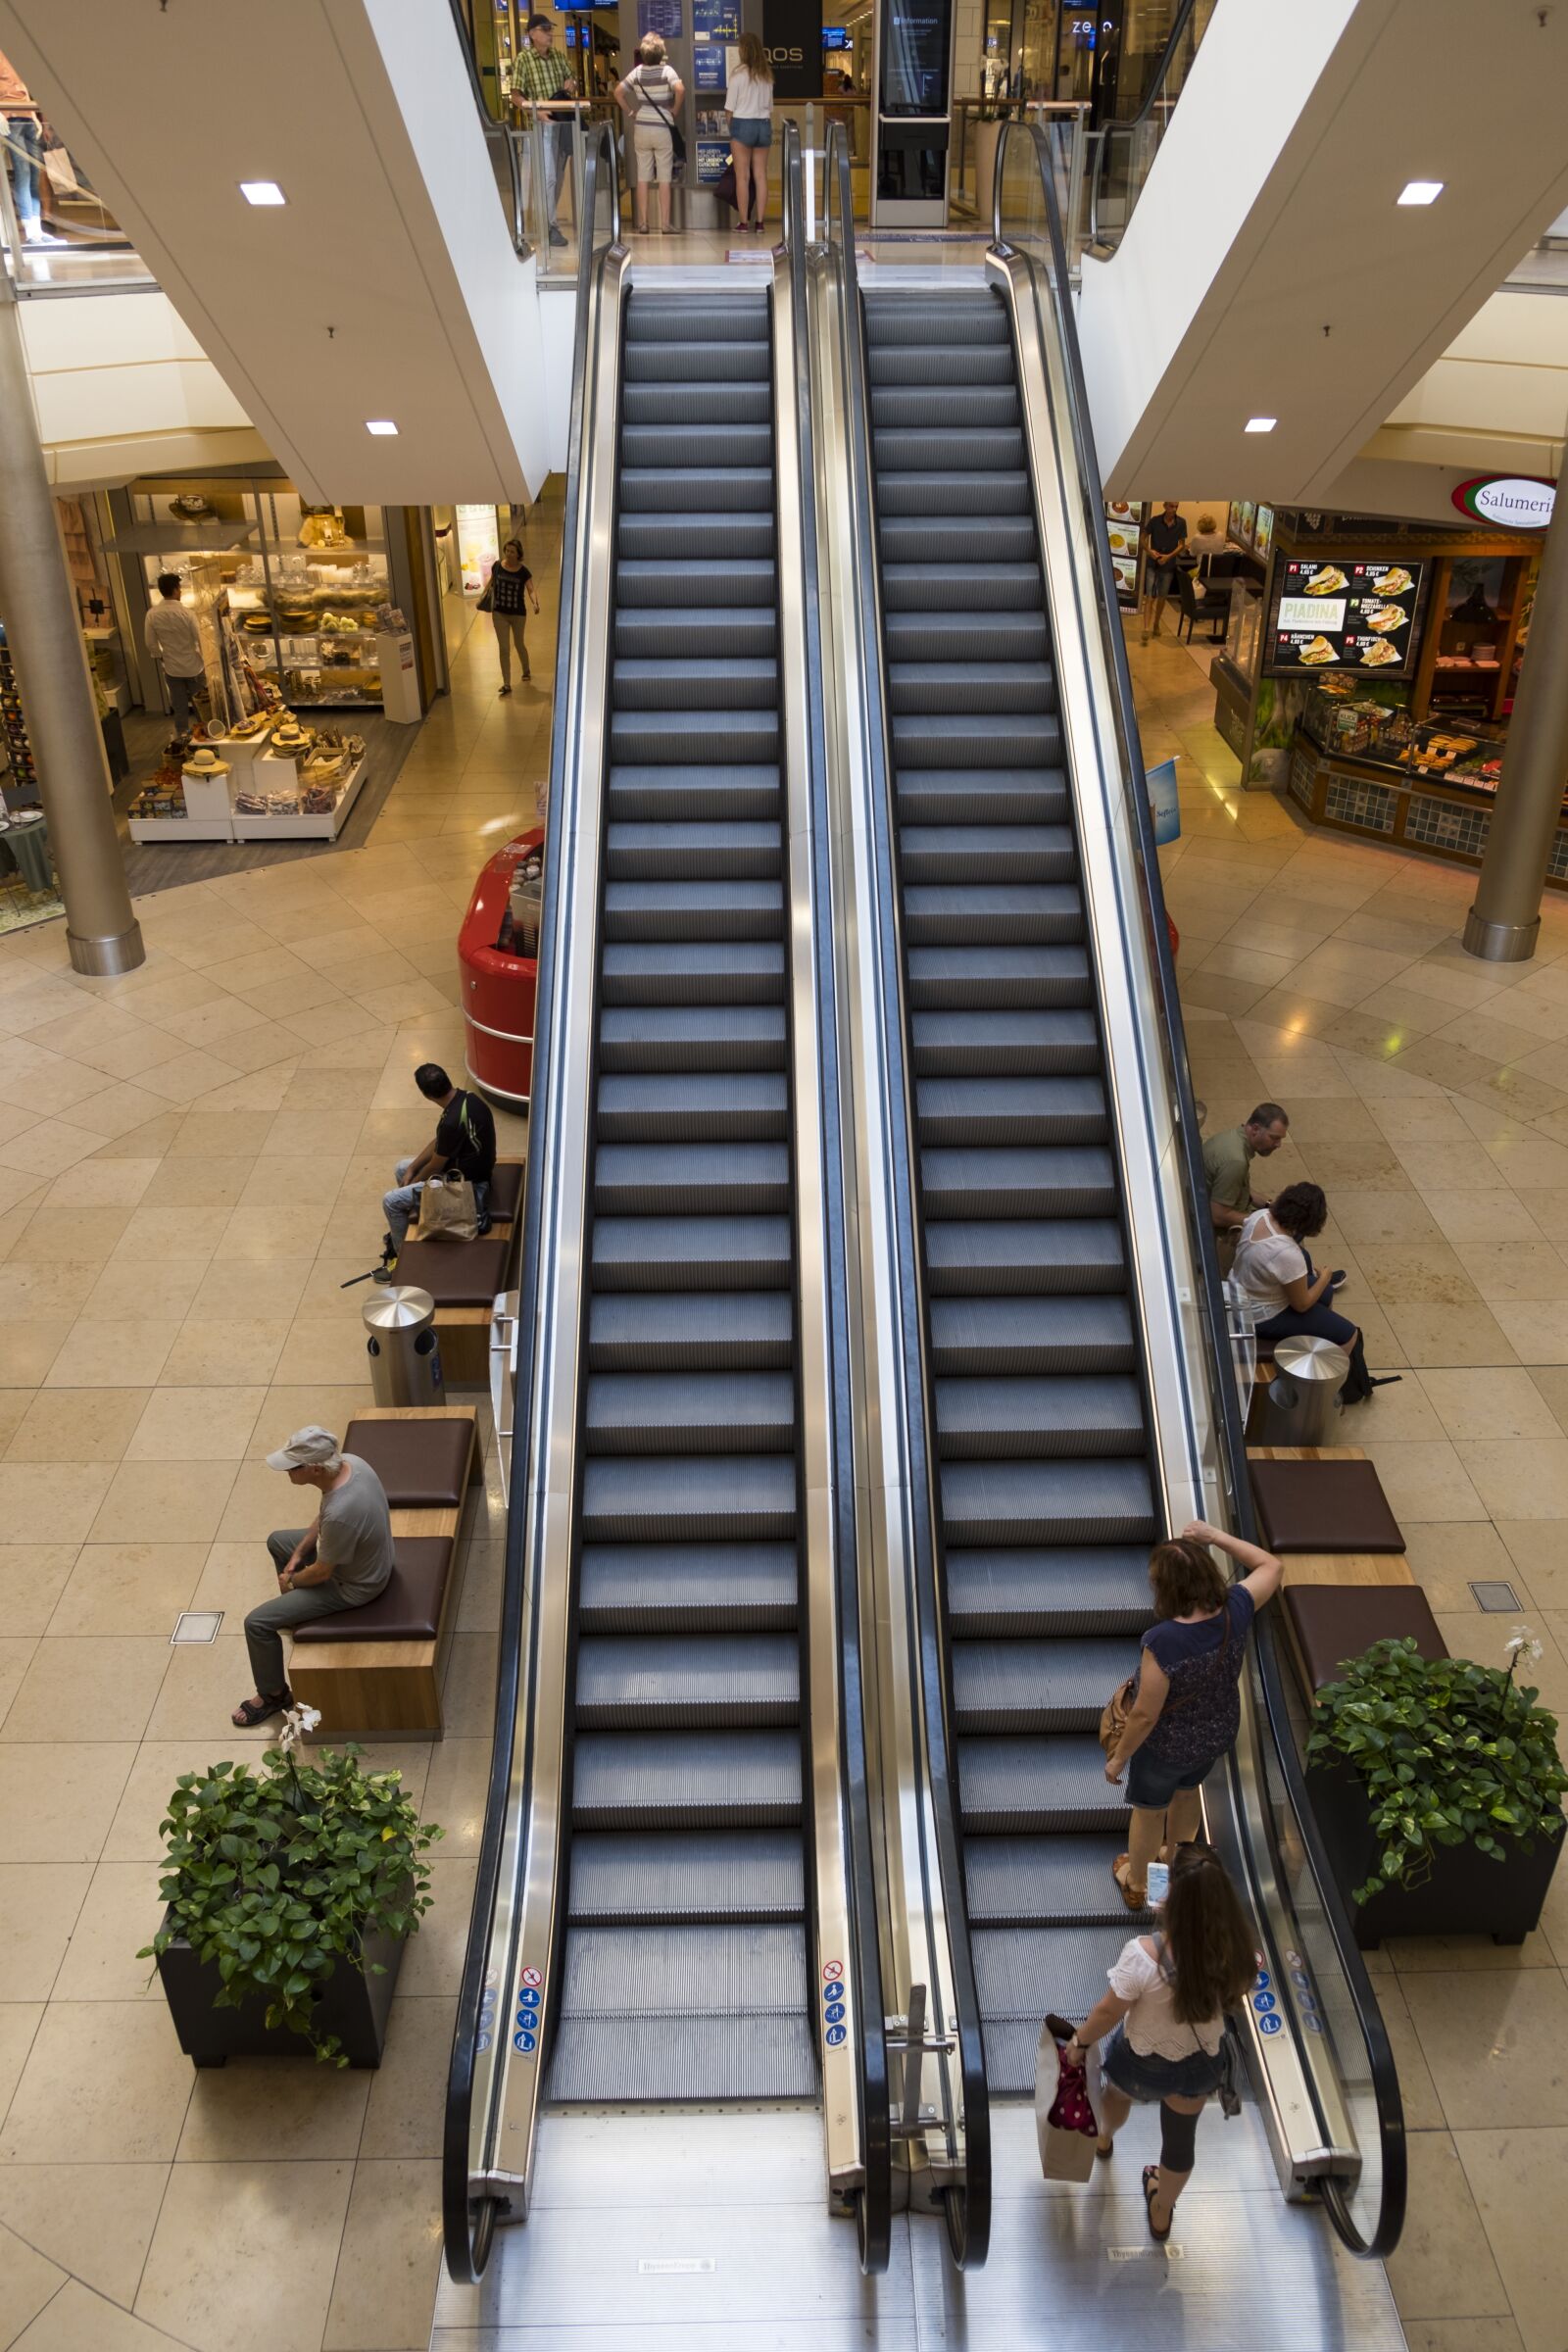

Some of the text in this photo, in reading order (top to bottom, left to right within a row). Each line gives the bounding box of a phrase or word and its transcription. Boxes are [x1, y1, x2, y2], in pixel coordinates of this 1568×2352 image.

[1072, 21, 1112, 33] zeo
[1480, 490, 1553, 514] Salumeri
[1284, 603, 1338, 619] PIADINA
